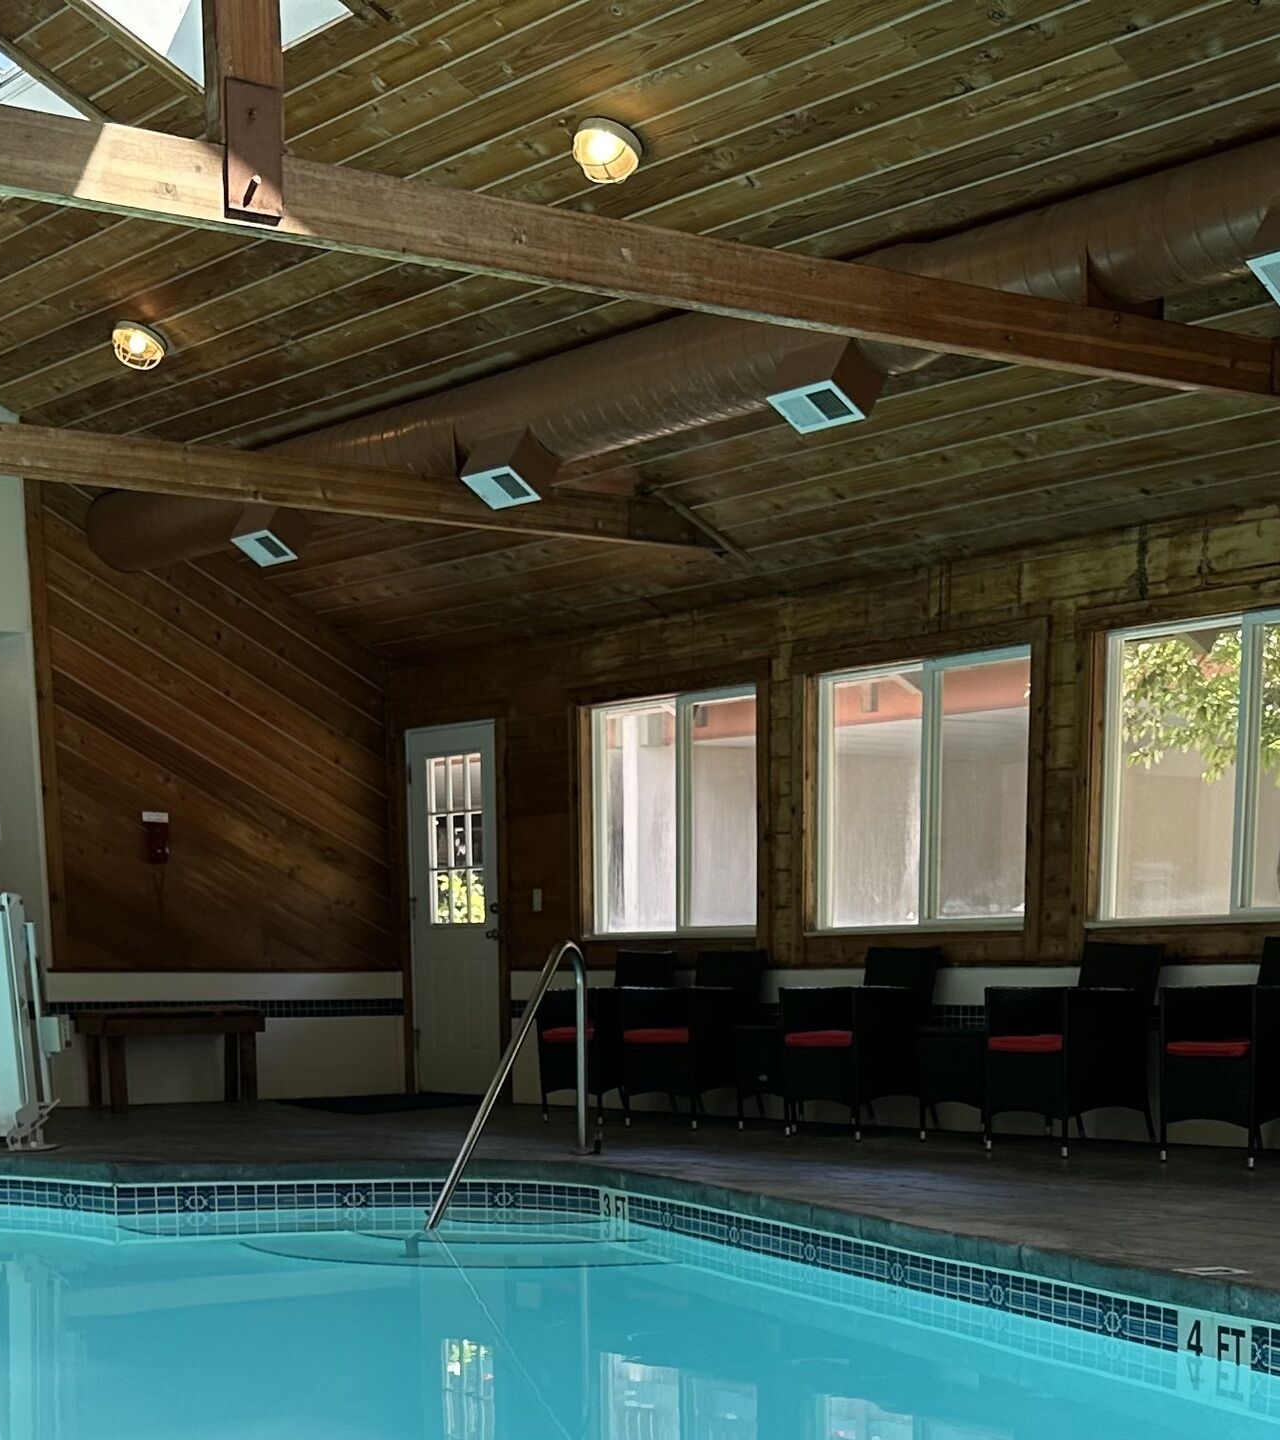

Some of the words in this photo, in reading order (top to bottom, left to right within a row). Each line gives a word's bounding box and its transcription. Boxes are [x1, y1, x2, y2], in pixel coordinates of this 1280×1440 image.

[603, 1193, 611, 1217] 3
[615, 1196, 626, 1220] FT
[1187, 1320, 1203, 1356] 4
[1217, 1325, 1245, 1366] FT
